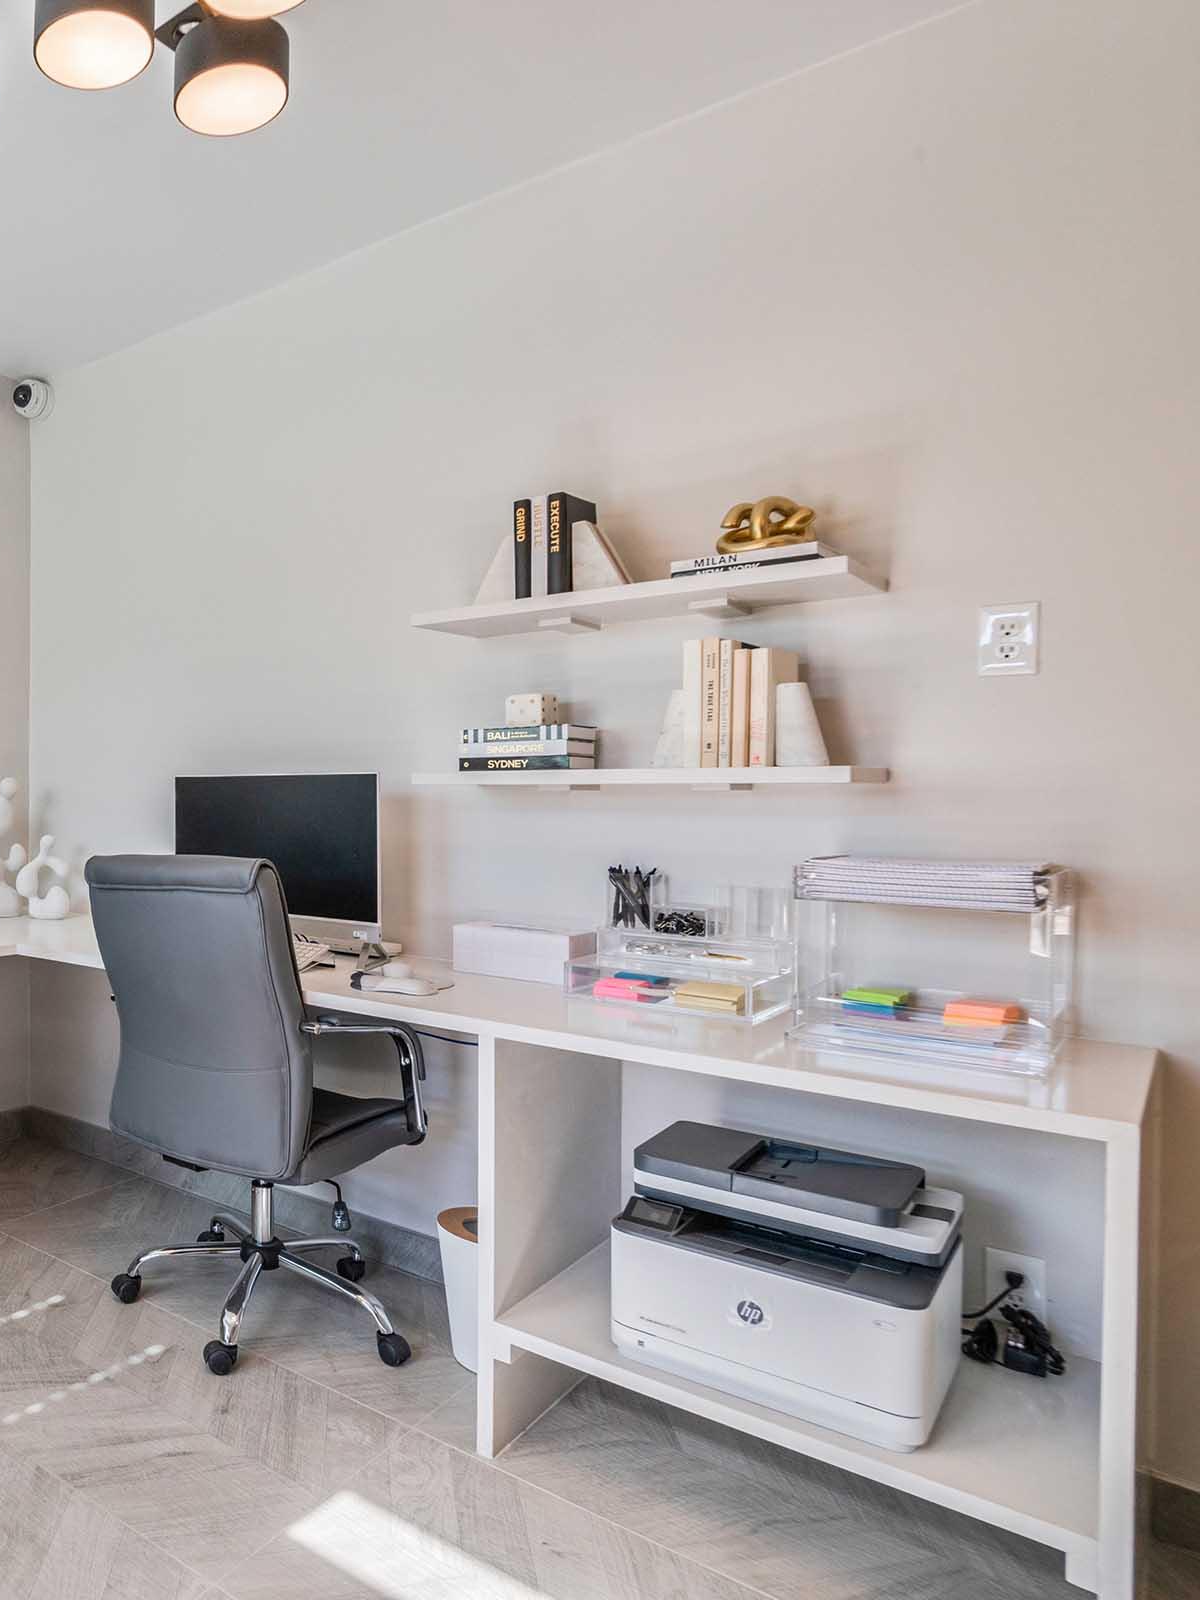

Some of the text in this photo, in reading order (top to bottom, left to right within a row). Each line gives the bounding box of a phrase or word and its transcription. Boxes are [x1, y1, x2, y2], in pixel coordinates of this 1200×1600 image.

[516, 508, 526, 542] GRIND
[550, 500, 560, 553] EXECUTE
[694, 555, 737, 567] MILAN
[487, 731, 511, 741] BALI
[487, 744, 544, 753] SINGAPORE
[487, 760, 528, 768] SYDNEY
[739, 1301, 762, 1325] hp
